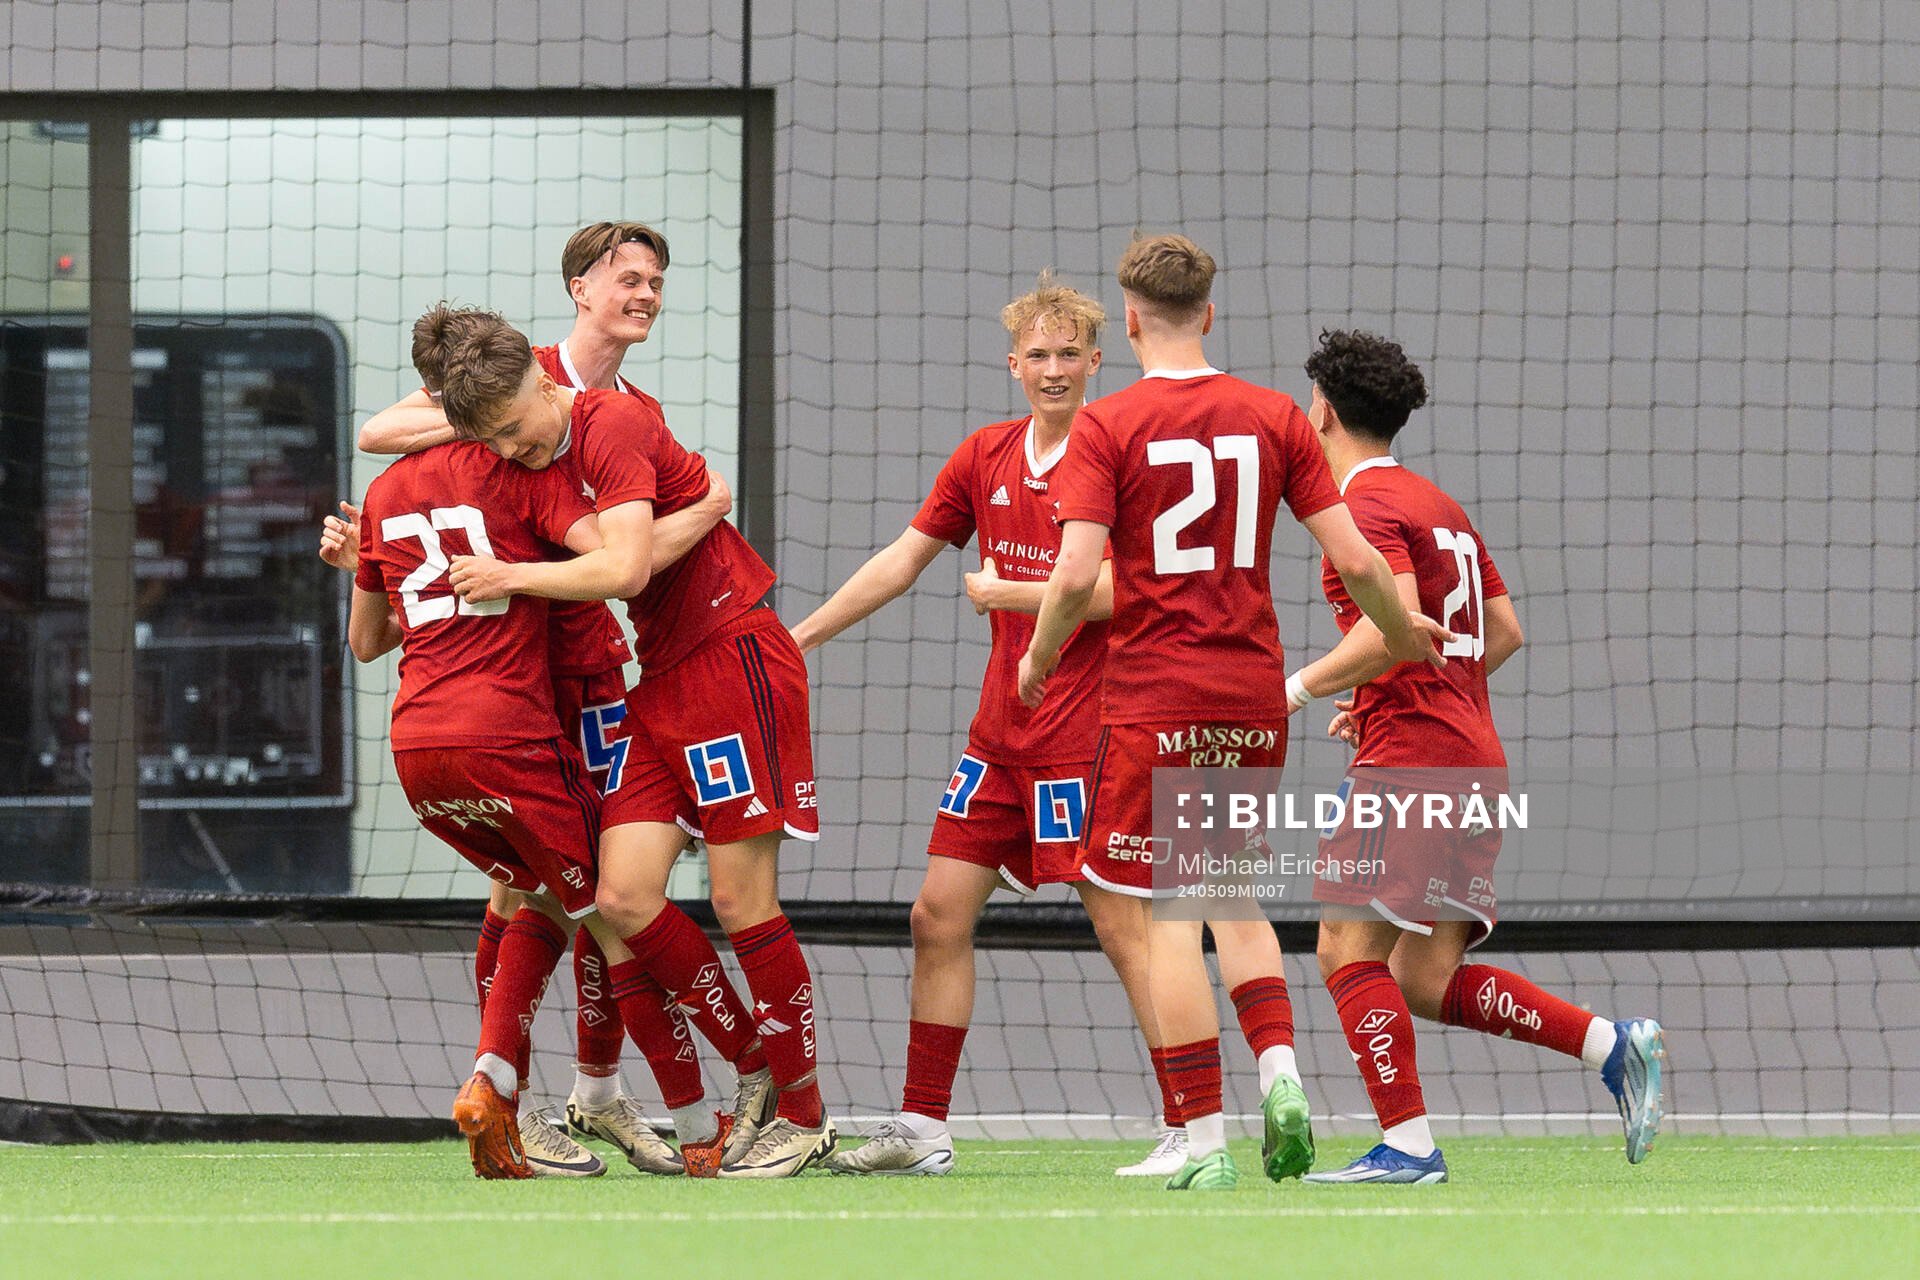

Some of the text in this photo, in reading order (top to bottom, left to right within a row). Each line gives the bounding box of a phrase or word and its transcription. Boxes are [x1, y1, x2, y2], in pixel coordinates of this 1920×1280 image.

[1147, 435, 1260, 575] 21
[1432, 527, 1485, 662] 20
[1156, 725, 1278, 755] MÅNSSON
[1190, 744, 1242, 770] RÖR
[1107, 846, 1153, 864] zero
[705, 986, 736, 1033] Ocab
[1497, 991, 1543, 1031] Ocab
[800, 1008, 816, 1059] Ocab
[1368, 1033, 1399, 1085] Ocab
